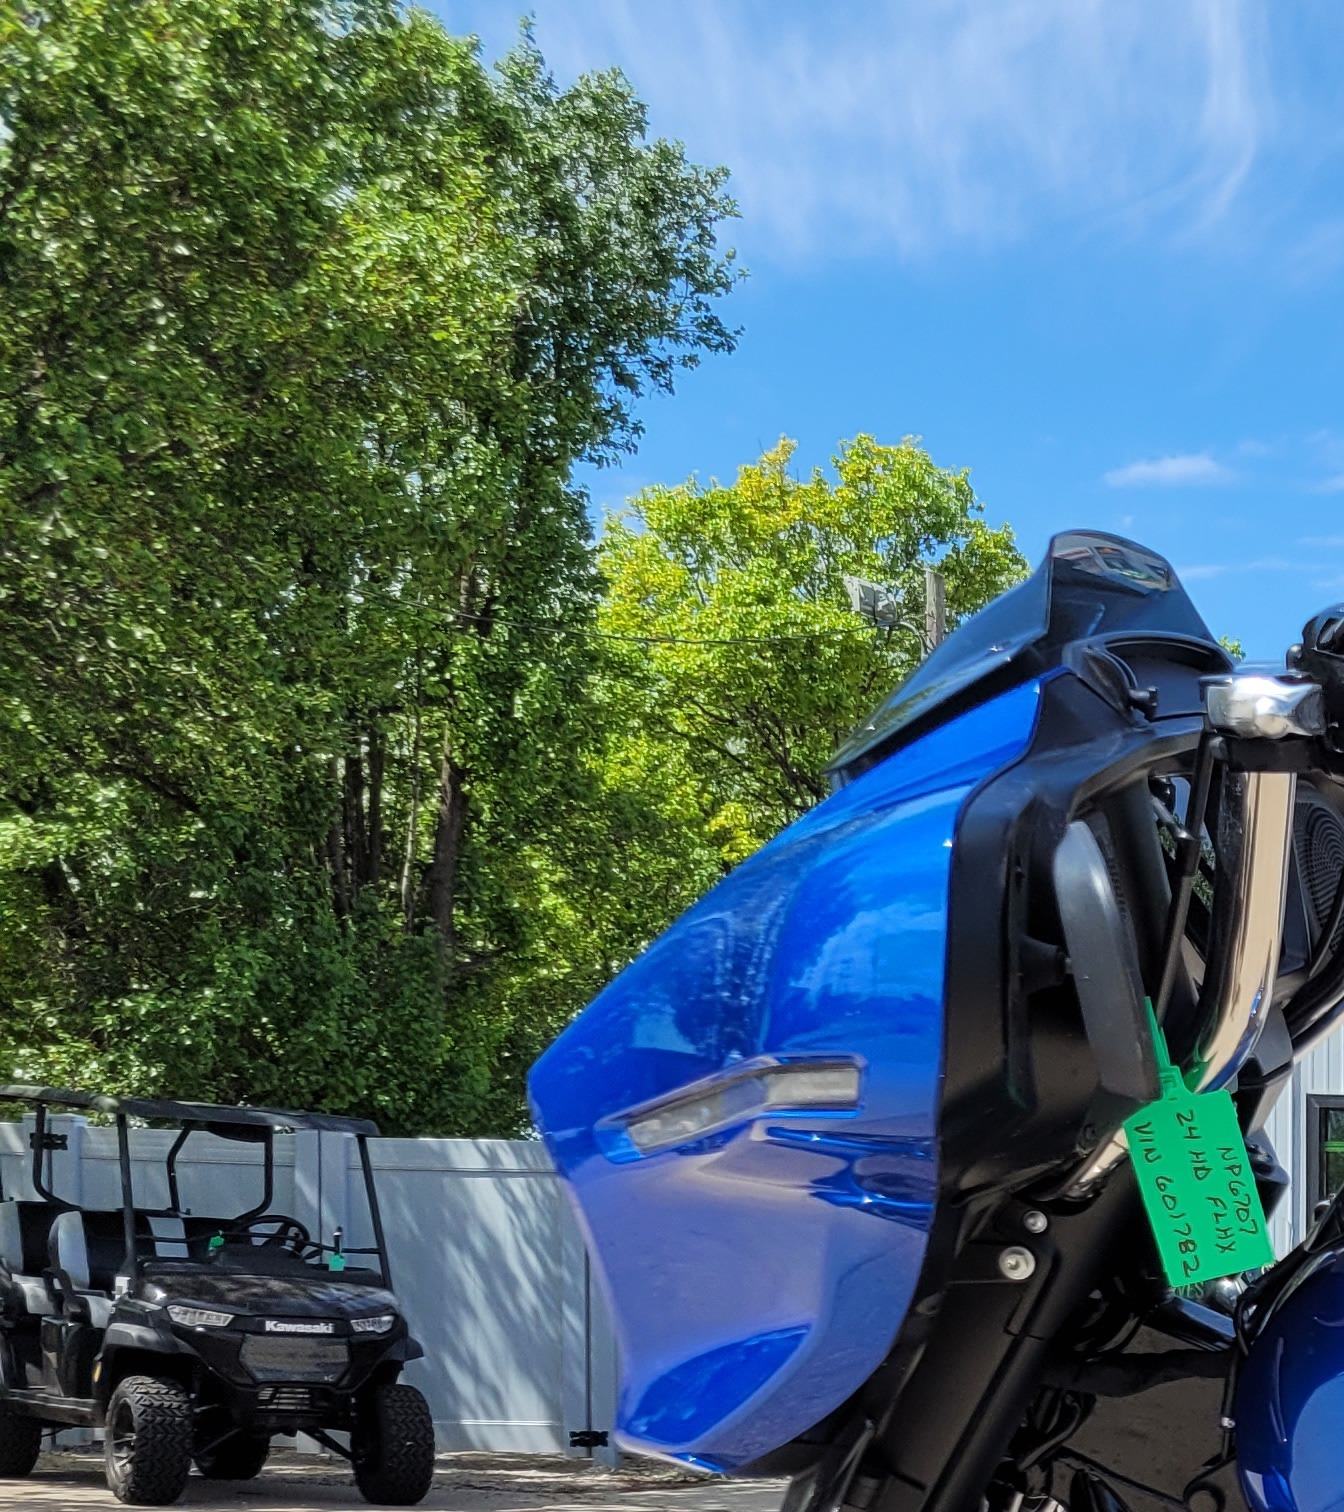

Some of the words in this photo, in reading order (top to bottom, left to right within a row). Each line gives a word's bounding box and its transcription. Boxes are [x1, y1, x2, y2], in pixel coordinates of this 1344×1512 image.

[1176, 1109, 1203, 1140] 24
[1206, 1196, 1237, 1255] FLHX
[265, 1320, 335, 1334] Kawasaki
